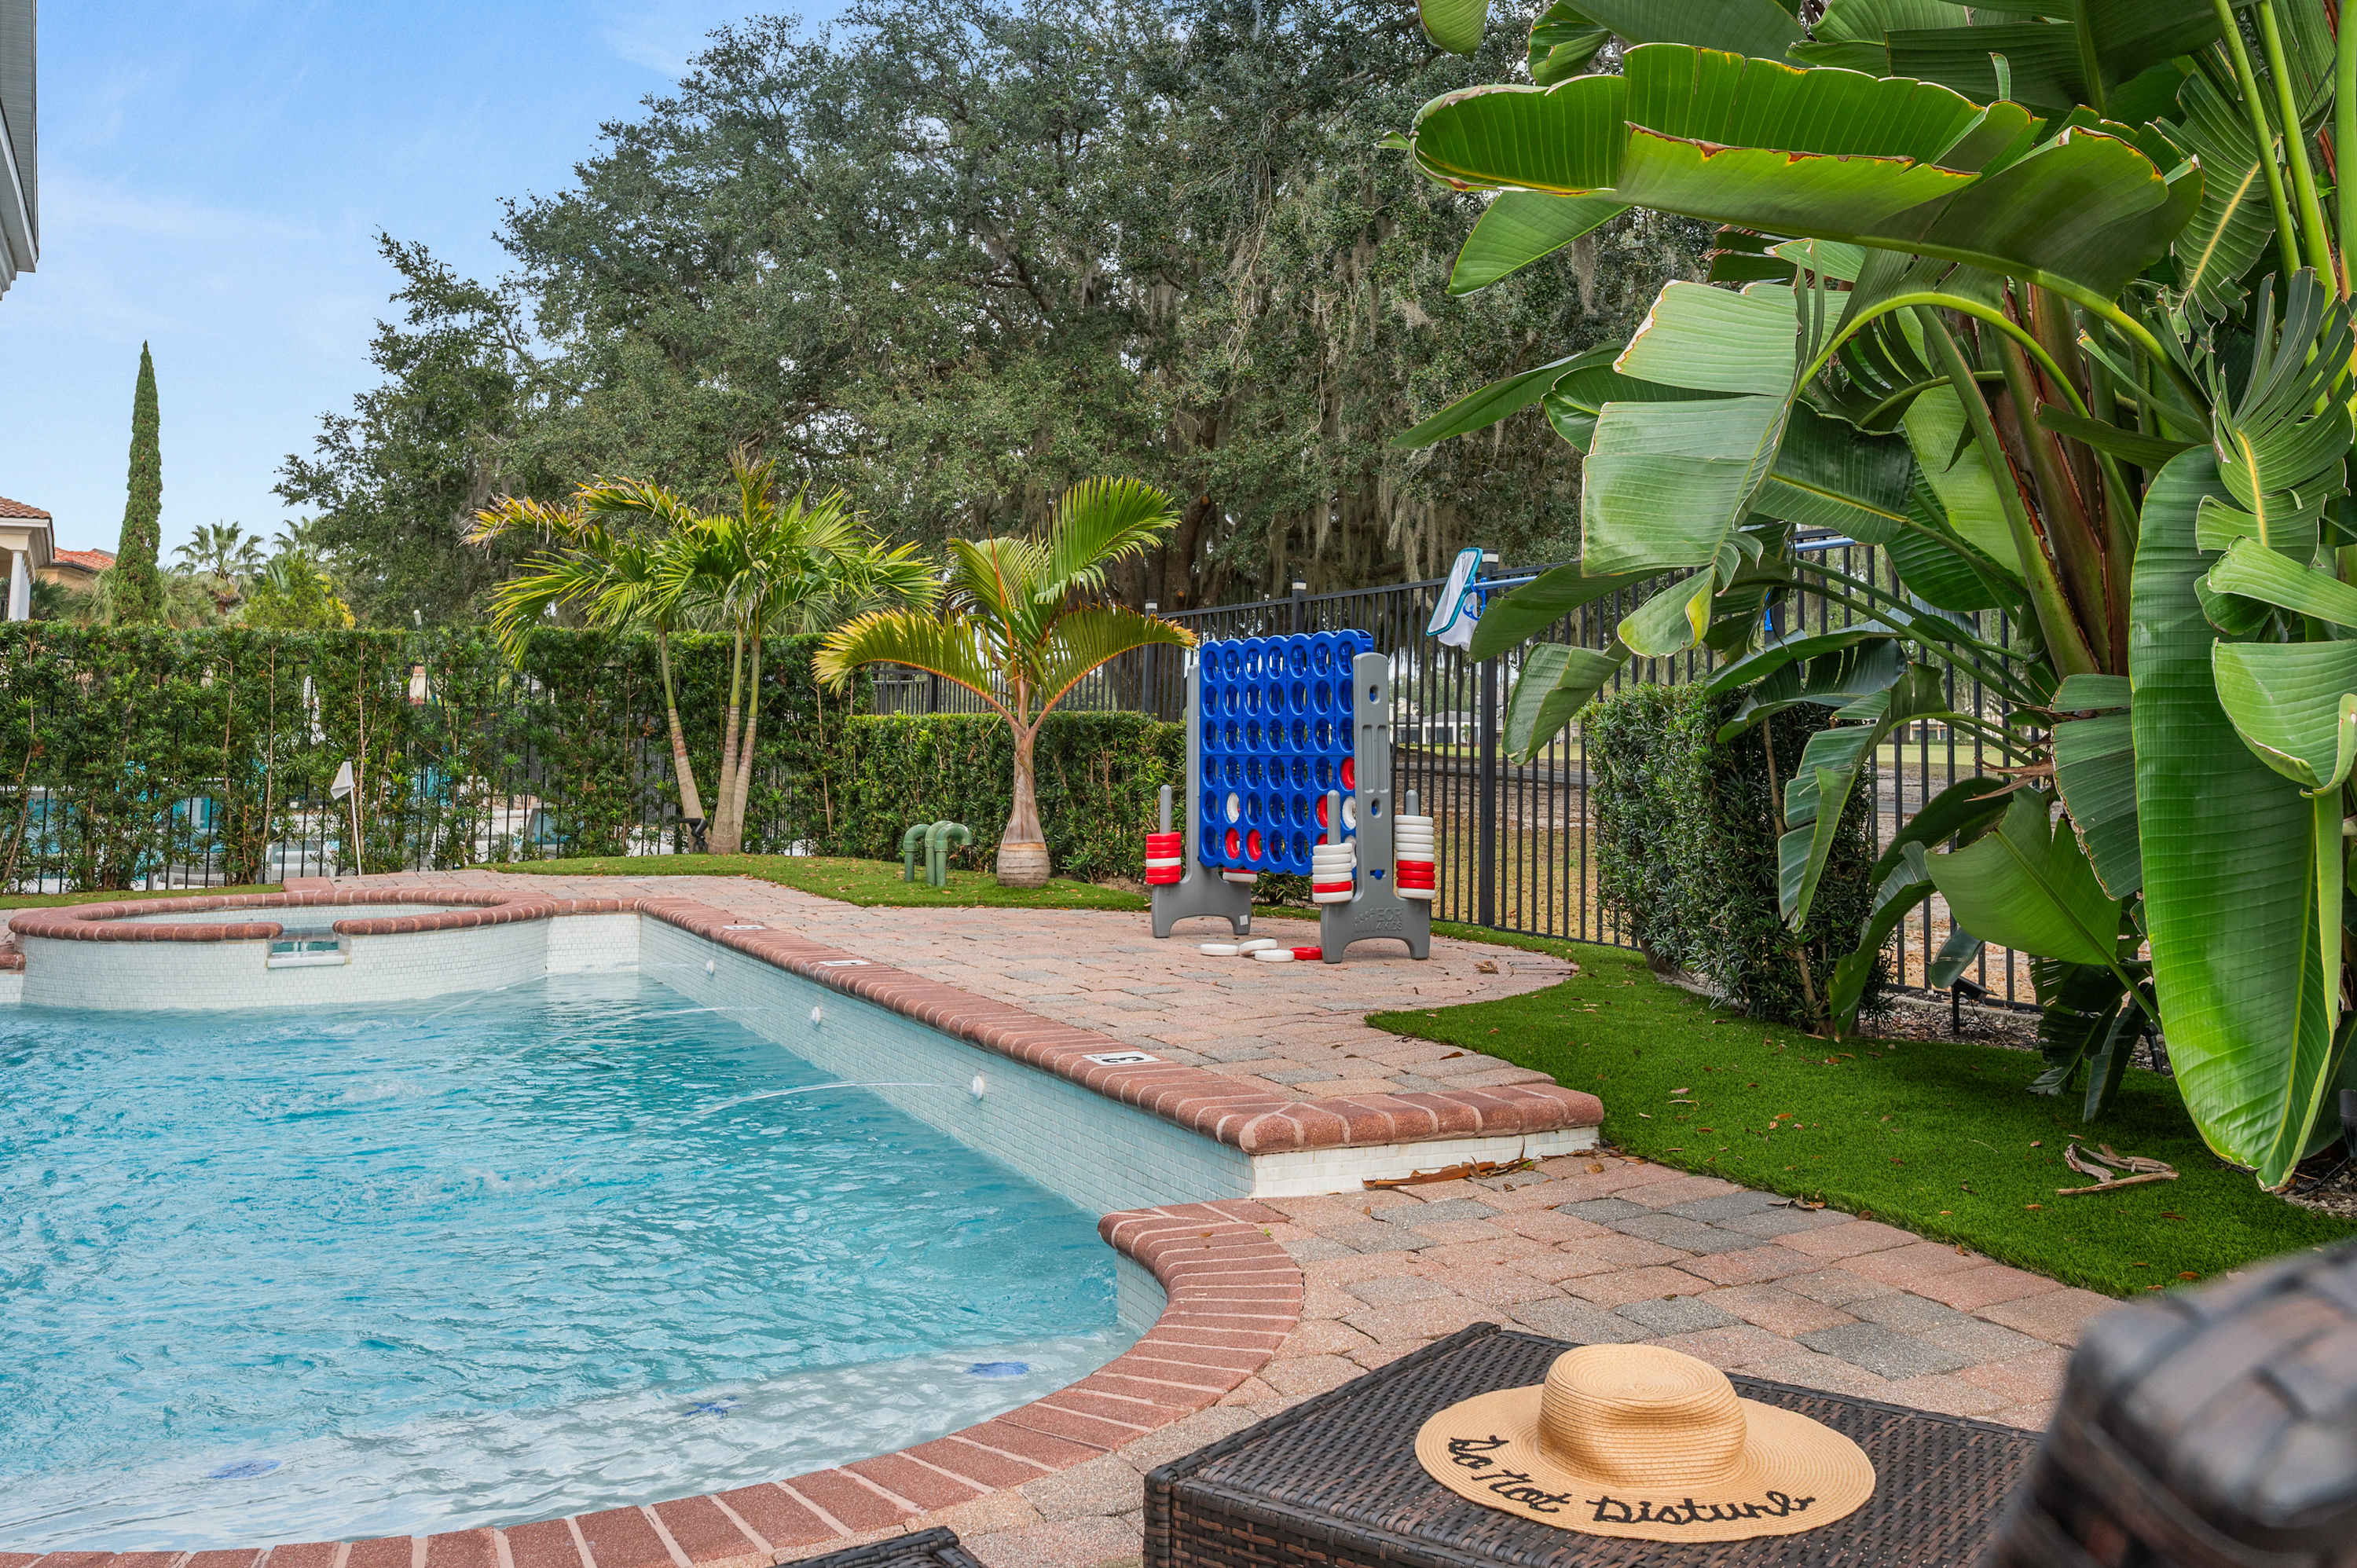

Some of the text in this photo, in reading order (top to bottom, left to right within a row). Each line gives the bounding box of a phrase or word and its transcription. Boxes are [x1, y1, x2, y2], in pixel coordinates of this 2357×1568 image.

[1448, 1434, 1816, 1525] Do Not Disturb
